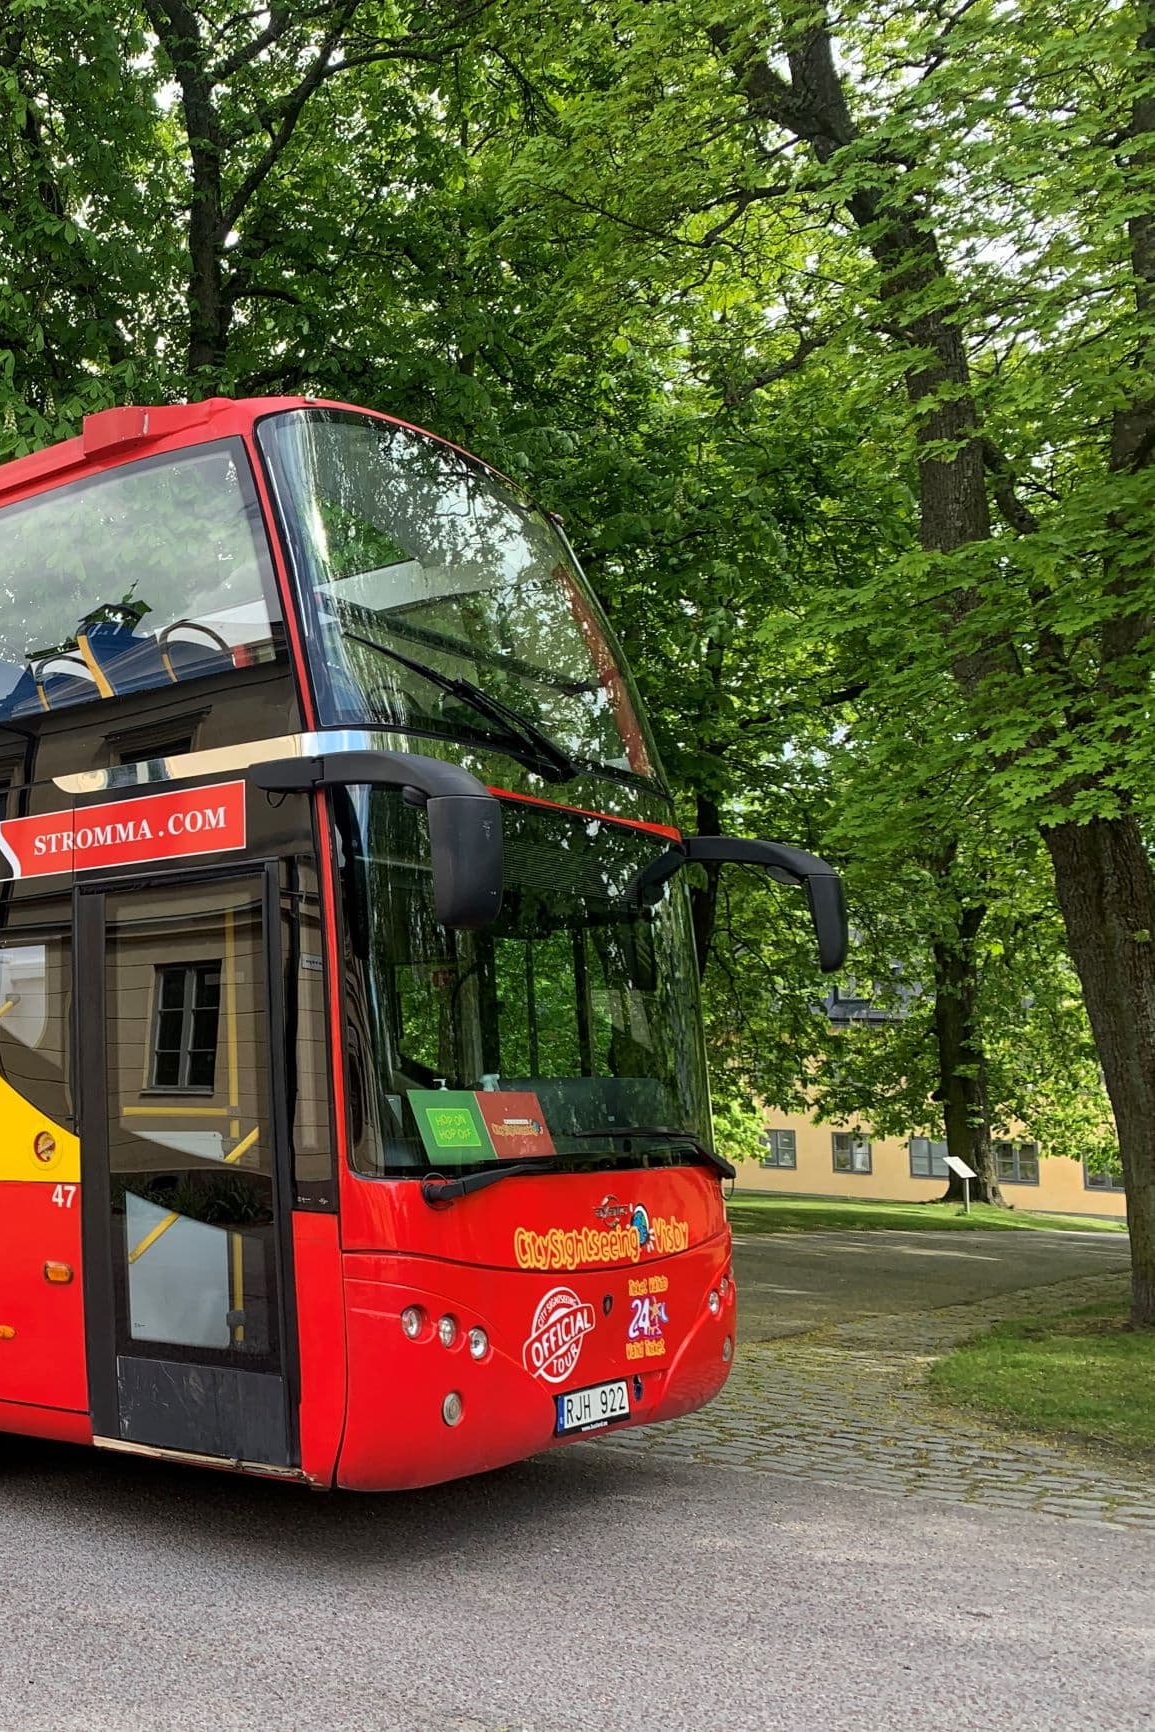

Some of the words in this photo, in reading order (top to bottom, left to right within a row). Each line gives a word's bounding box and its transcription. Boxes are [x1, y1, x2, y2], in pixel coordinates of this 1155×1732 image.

[436, 1114, 452, 1126] HOP
[453, 1114, 466, 1126] ON
[439, 1128, 456, 1140] HOP
[51, 1183, 77, 1209] 47
[652, 1215, 689, 1253] Visby
[537, 1308, 548, 1329] CITY
[531, 1308, 592, 1368] OFFICIAL
[553, 1343, 579, 1375] TOUR
[566, 1393, 592, 1425] RJH
[600, 1386, 626, 1414] 922
